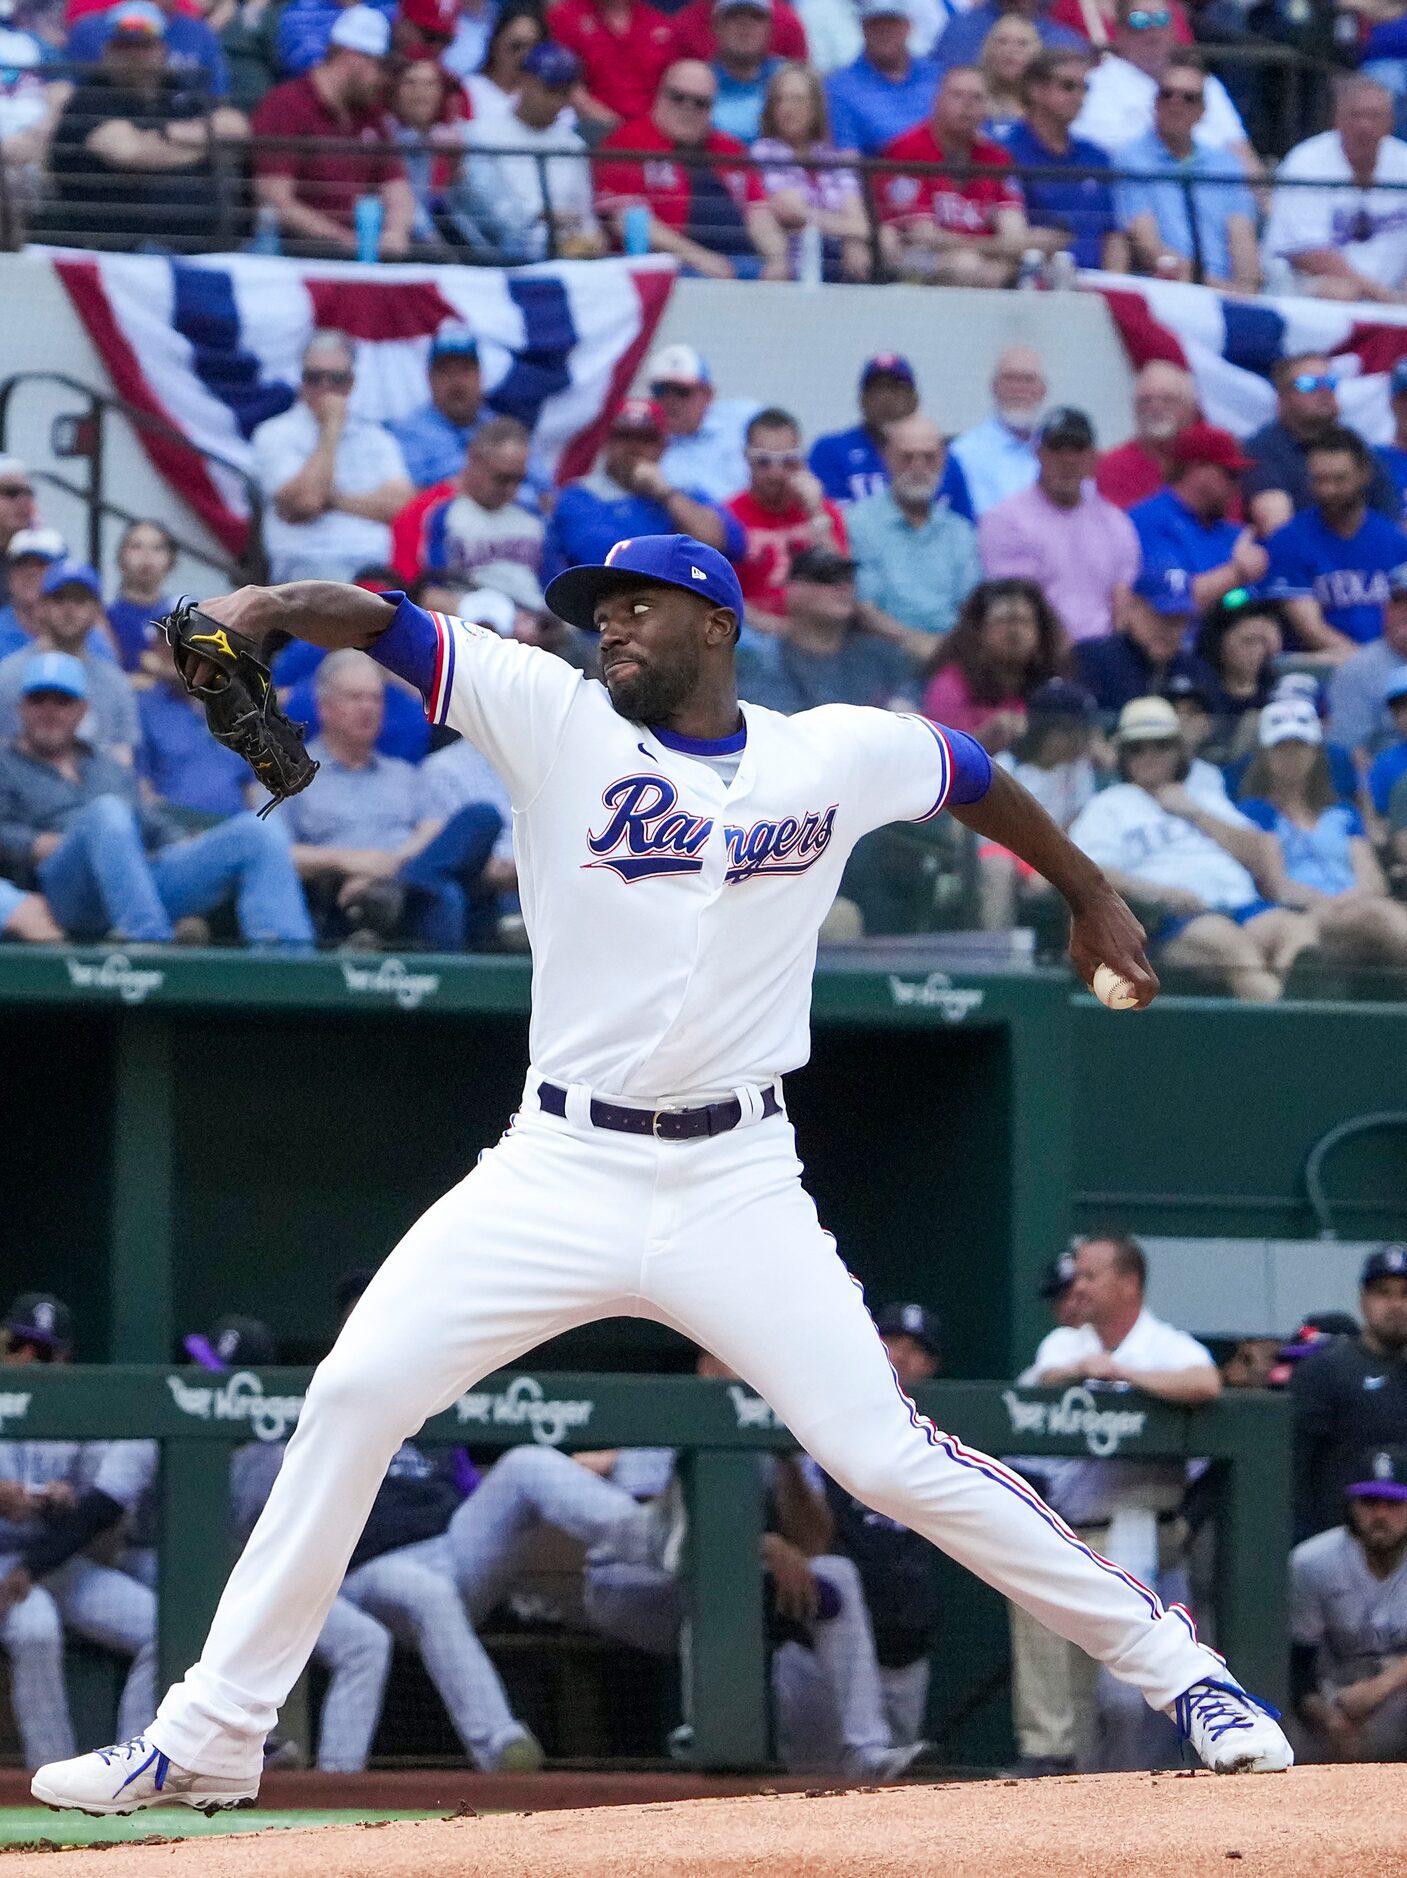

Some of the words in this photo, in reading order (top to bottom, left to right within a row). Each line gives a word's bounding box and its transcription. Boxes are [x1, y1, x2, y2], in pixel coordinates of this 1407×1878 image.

[586, 772, 840, 886] Rangers
[214, 1371, 305, 1441] Kroge
[494, 1375, 594, 1447] Kroger
[1048, 1386, 1146, 1457] Kroger
